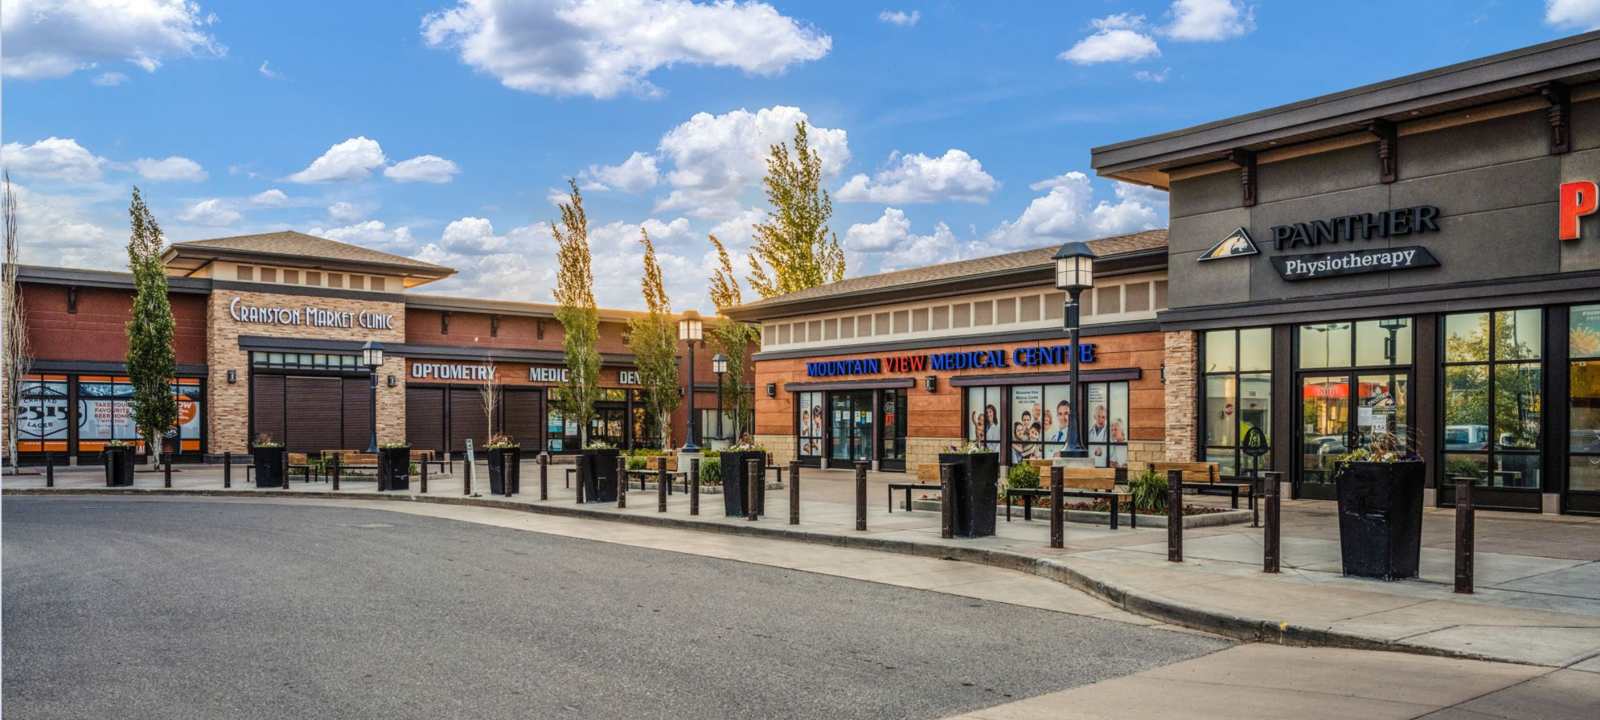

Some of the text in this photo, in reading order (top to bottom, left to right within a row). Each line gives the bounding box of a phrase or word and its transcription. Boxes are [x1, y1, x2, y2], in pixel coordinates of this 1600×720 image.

[1271, 205, 1440, 250] PANTHER
[1285, 249, 1416, 276] Physiotherapy
[230, 297, 393, 330] CRANSTON MARKET CLINIC
[412, 362, 496, 380] OPTOMETRY
[529, 367, 569, 382] MEDIC
[807, 358, 881, 377] MOUNTAIN
[884, 353, 929, 373] VIEW
[931, 350, 1010, 371] MEDICAL
